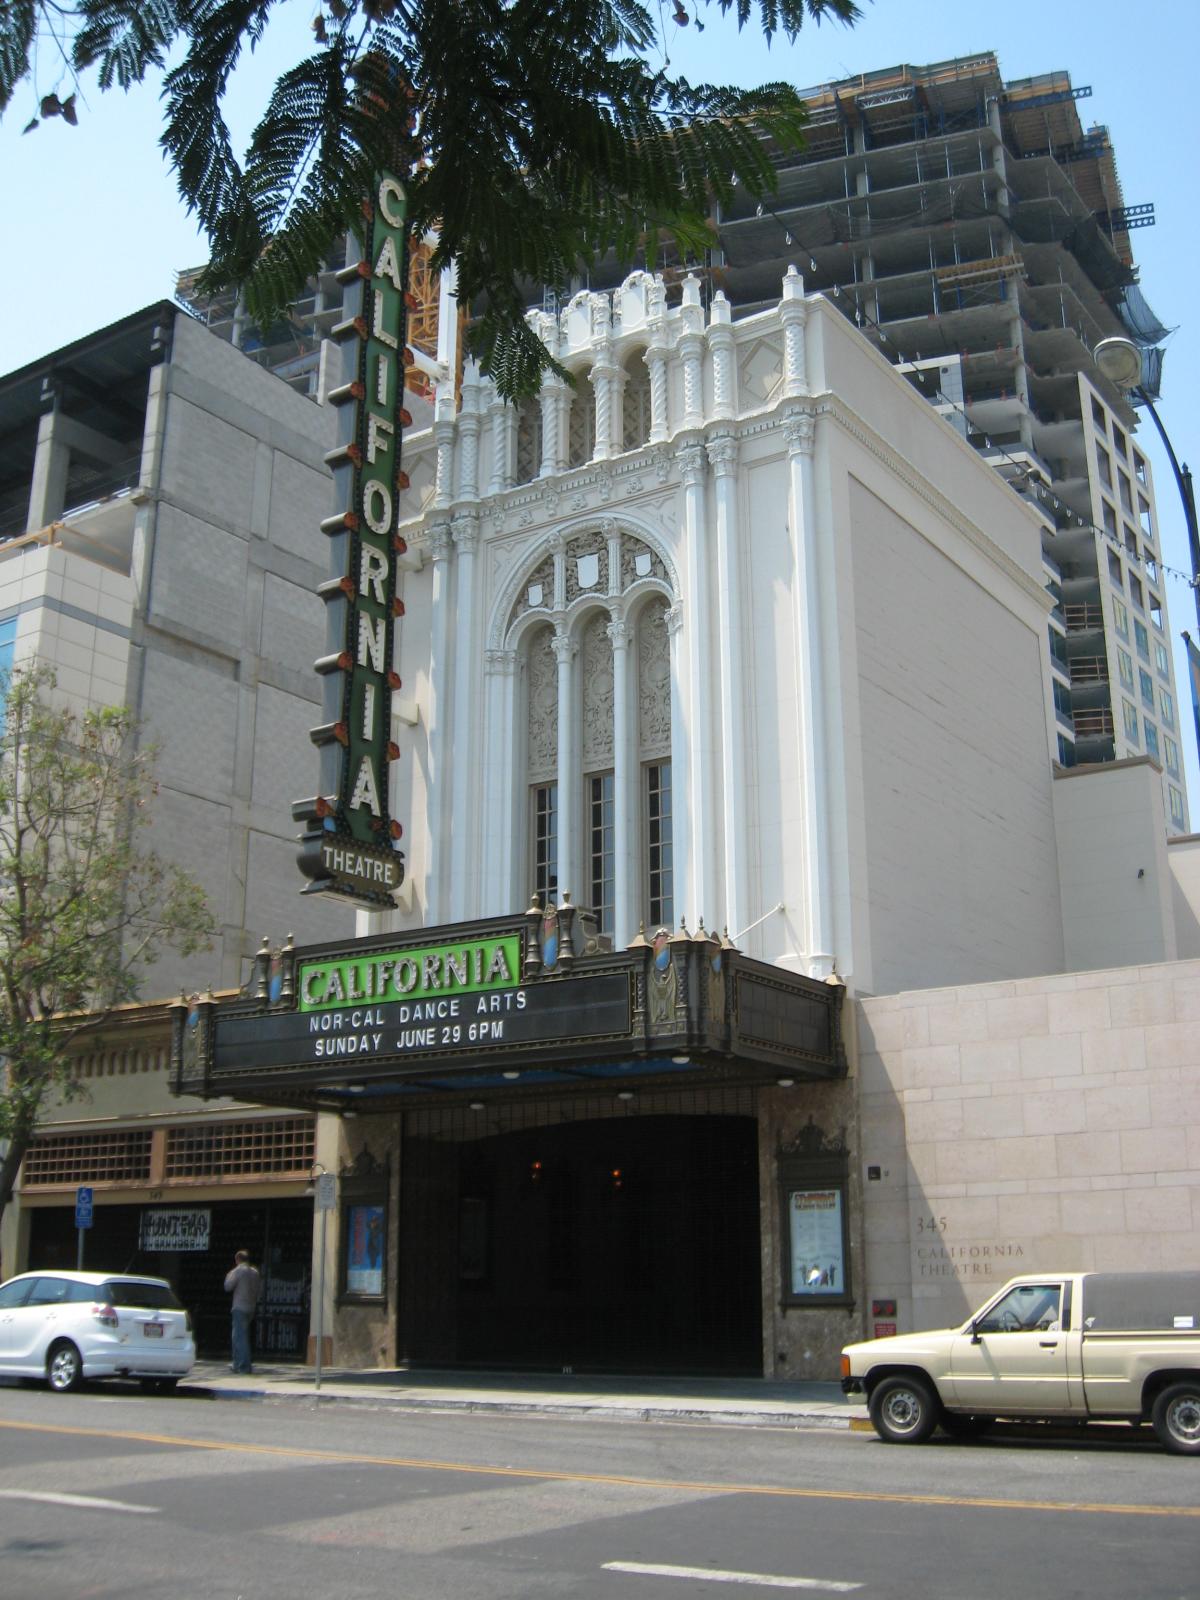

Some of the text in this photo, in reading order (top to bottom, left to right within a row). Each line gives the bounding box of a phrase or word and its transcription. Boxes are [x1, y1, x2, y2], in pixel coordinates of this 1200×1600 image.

[350, 178, 406, 817] CALIFORNIA
[323, 846, 393, 885] THEATRE
[301, 945, 512, 1007] CALIFORNIA
[309, 991, 527, 1033] NOR-CAL DANCE ARTS
[315, 1020, 504, 1057] SUNDAY JUNE 29 6PM
[917, 1217, 947, 1233] 345
[917, 1245, 1025, 1259] CALIFORNIA
[920, 1263, 993, 1276] THEATRE
